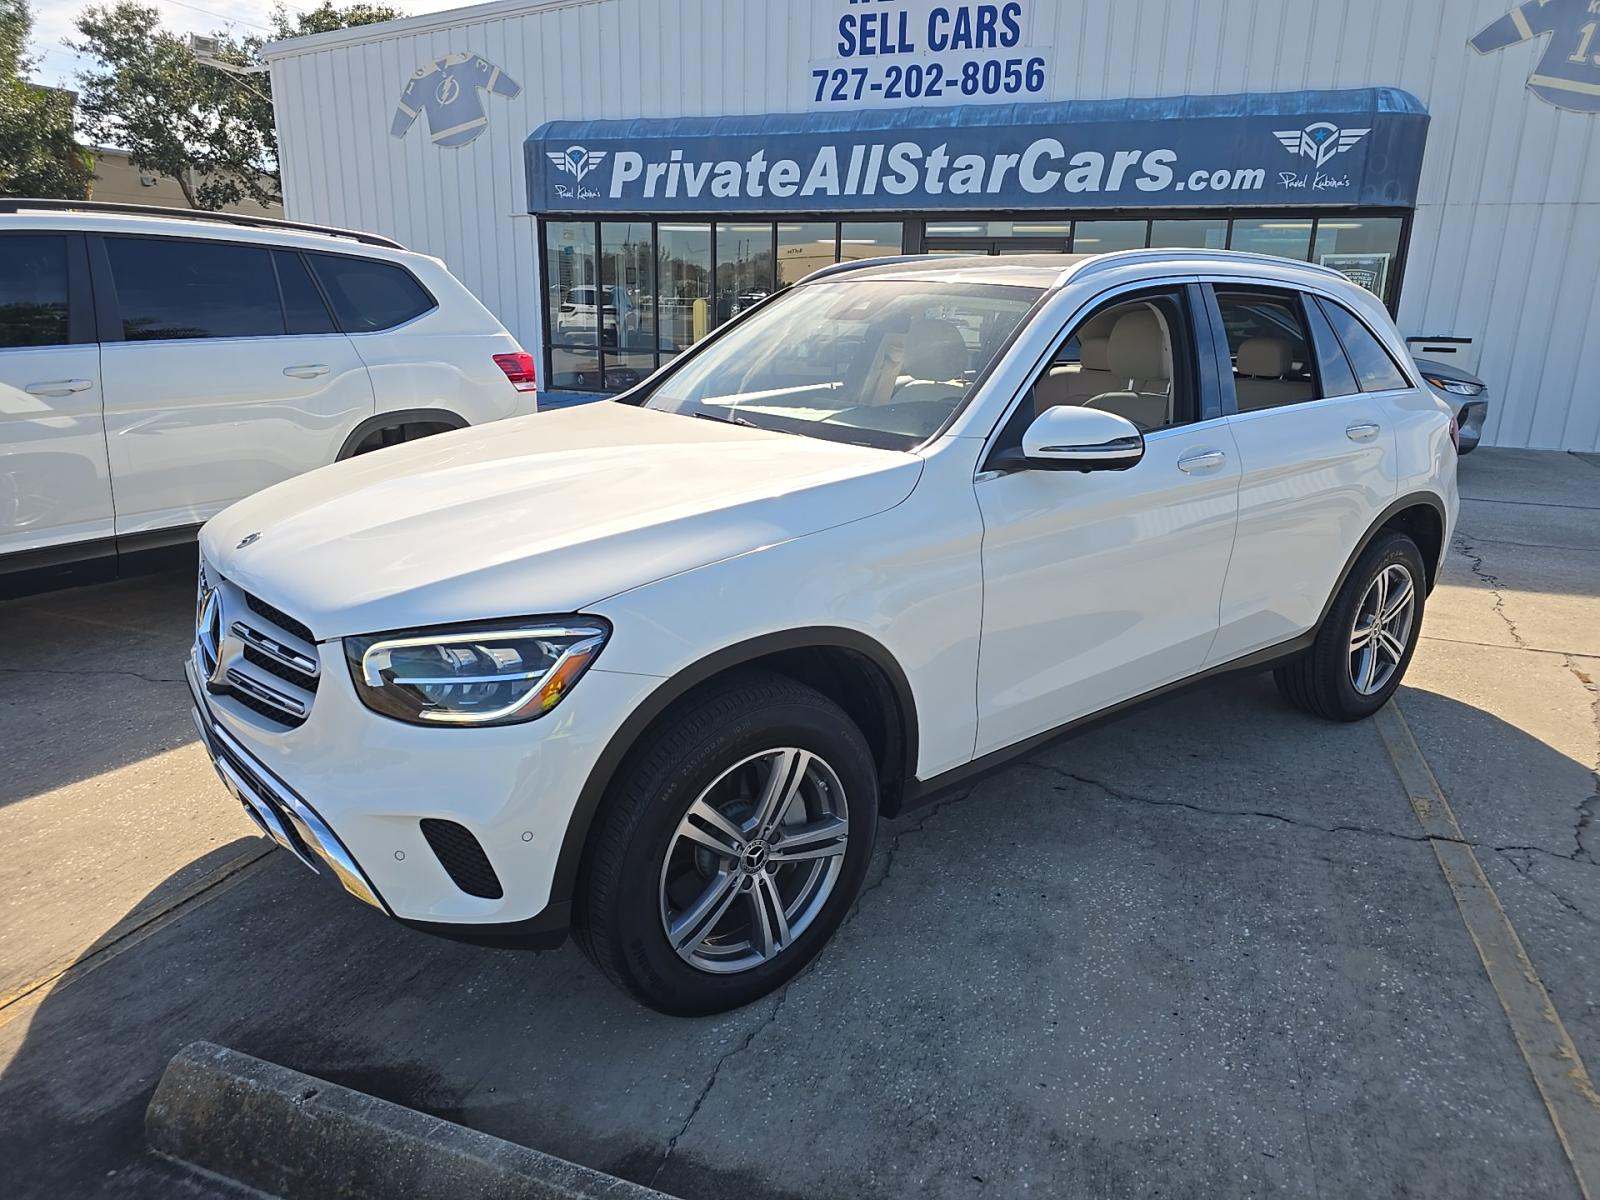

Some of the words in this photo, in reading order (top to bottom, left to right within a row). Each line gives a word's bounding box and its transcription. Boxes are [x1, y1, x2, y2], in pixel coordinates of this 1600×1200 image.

[837, 11, 914, 57] SELL
[927, 2, 1022, 51] CARS
[812, 57, 1045, 102] 727-202-8056
[609, 137, 1266, 199] PrivateAllStarCars.com
